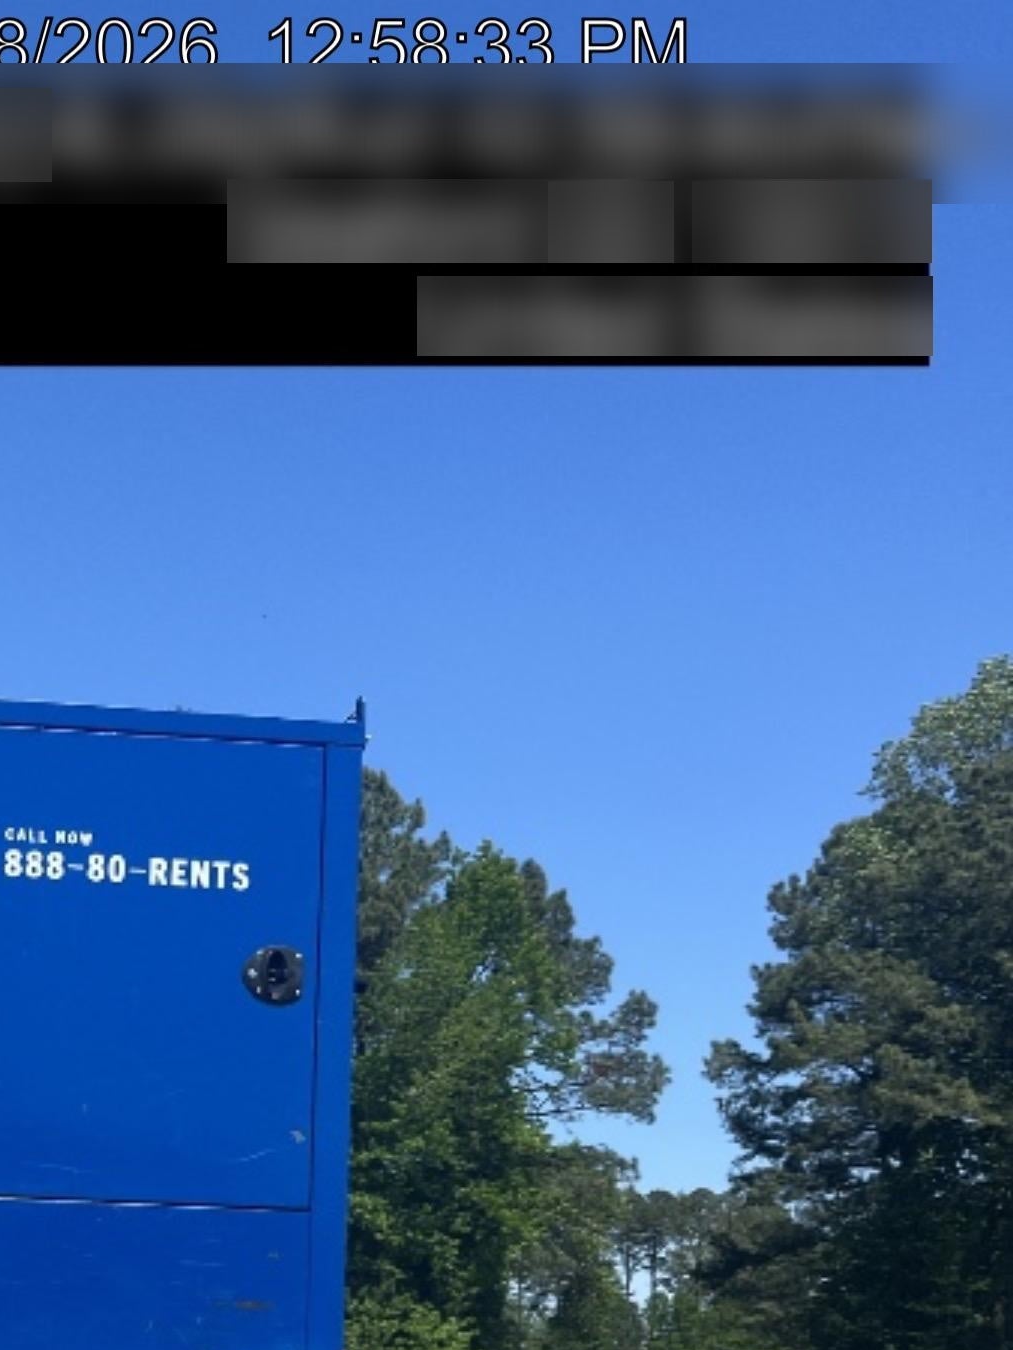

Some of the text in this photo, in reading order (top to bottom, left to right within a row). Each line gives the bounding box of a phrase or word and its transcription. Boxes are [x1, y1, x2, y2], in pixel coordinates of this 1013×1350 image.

[4, 827, 93, 846] CALL NOW
[3, 848, 251, 891] 888-80-RENTS
